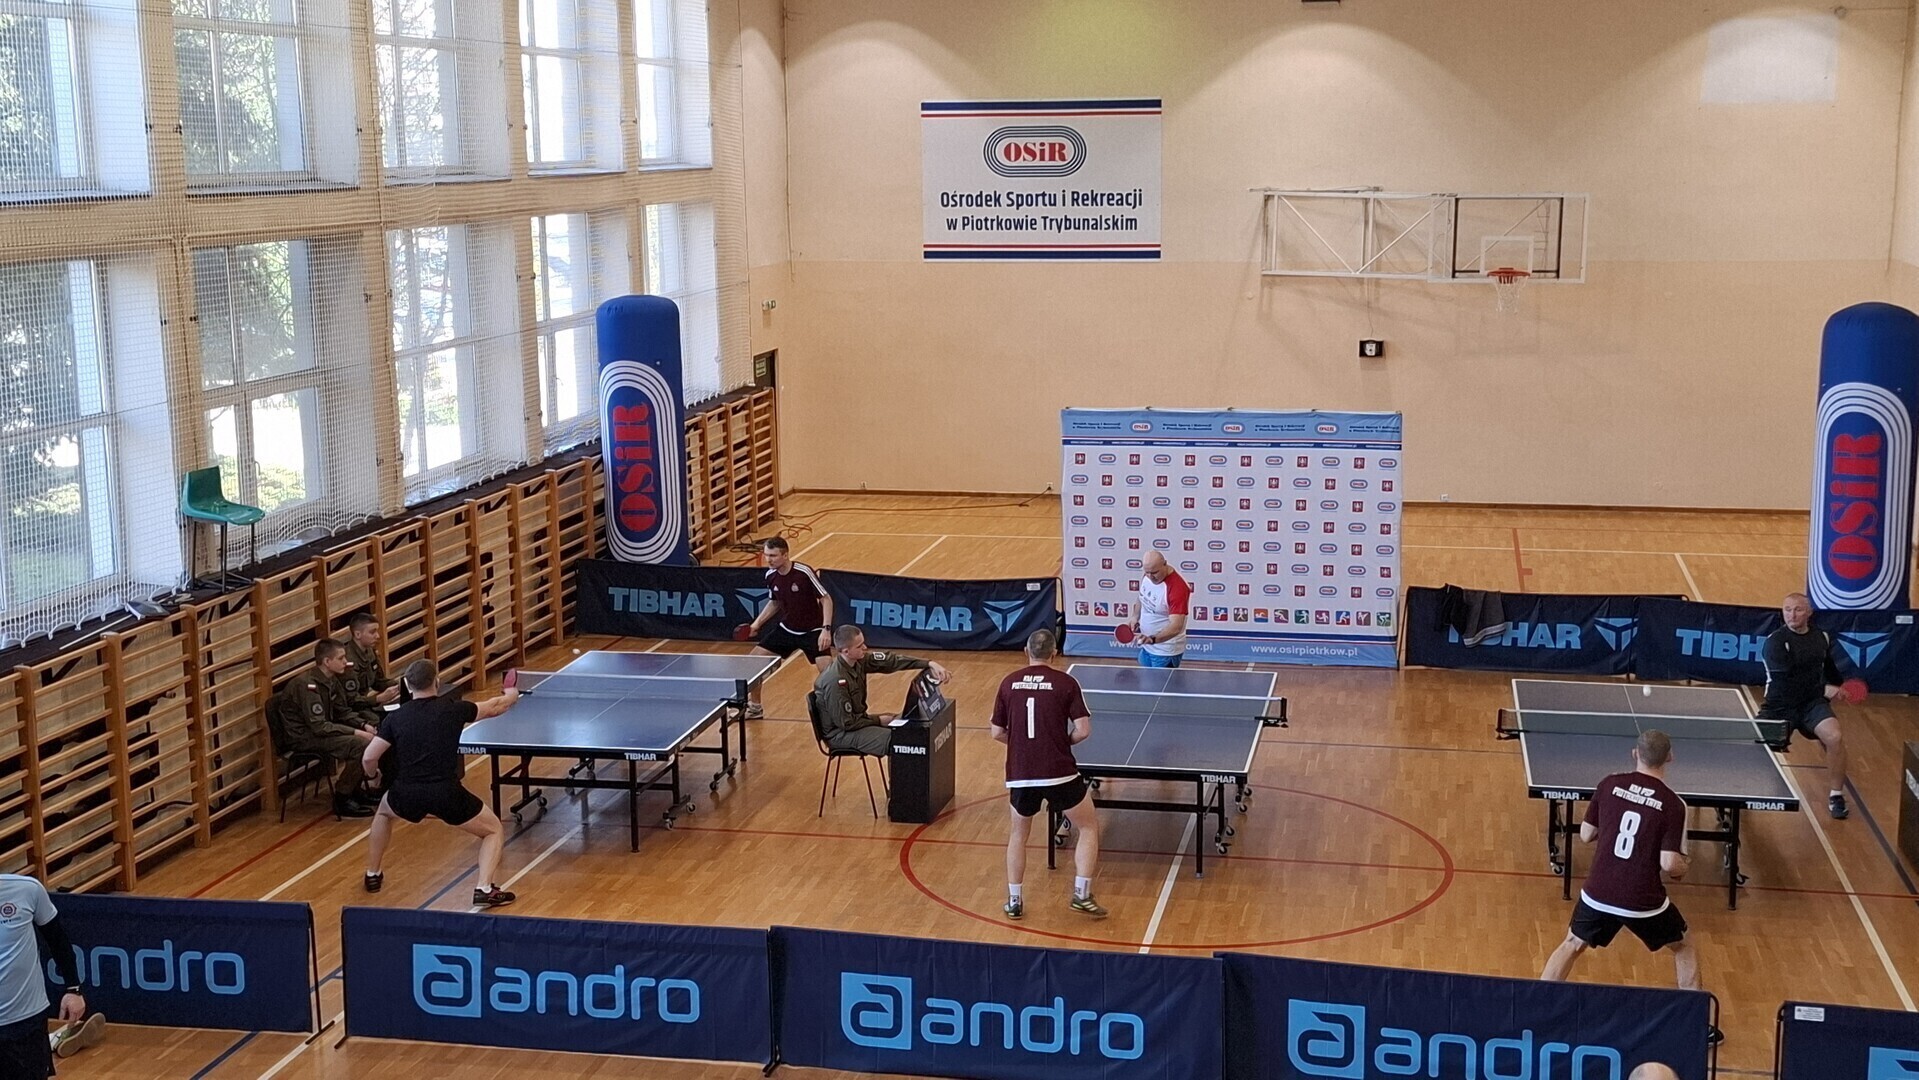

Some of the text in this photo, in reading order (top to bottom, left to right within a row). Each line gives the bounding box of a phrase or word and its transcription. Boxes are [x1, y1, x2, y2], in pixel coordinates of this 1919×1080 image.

[1003, 141, 1068, 162] OSiR
[940, 189, 1143, 210] Ośrodek Sportu i Rekreacji
[946, 215, 1138, 234] w Piotrkowie Trybunalskim
[613, 402, 657, 532] OSiR
[1828, 432, 1882, 580] OSiR
[608, 586, 726, 618] TIBHAR
[850, 599, 973, 632] TIBHAR
[1250, 645, 1358, 658] www.osirpiotrkow.pl
[1675, 628, 1768, 663] TIBH
[1026, 697, 1035, 739] 1
[624, 752, 657, 761] TIBHAR
[893, 745, 926, 755] TIBHAR
[1200, 774, 1236, 784] TIBHAR
[1541, 790, 1580, 800] TIBHAR
[1745, 801, 1785, 811] TIBHAR
[1614, 810, 1641, 860] 8
[489, 964, 701, 1024] andro
[920, 996, 1145, 1060] andro
